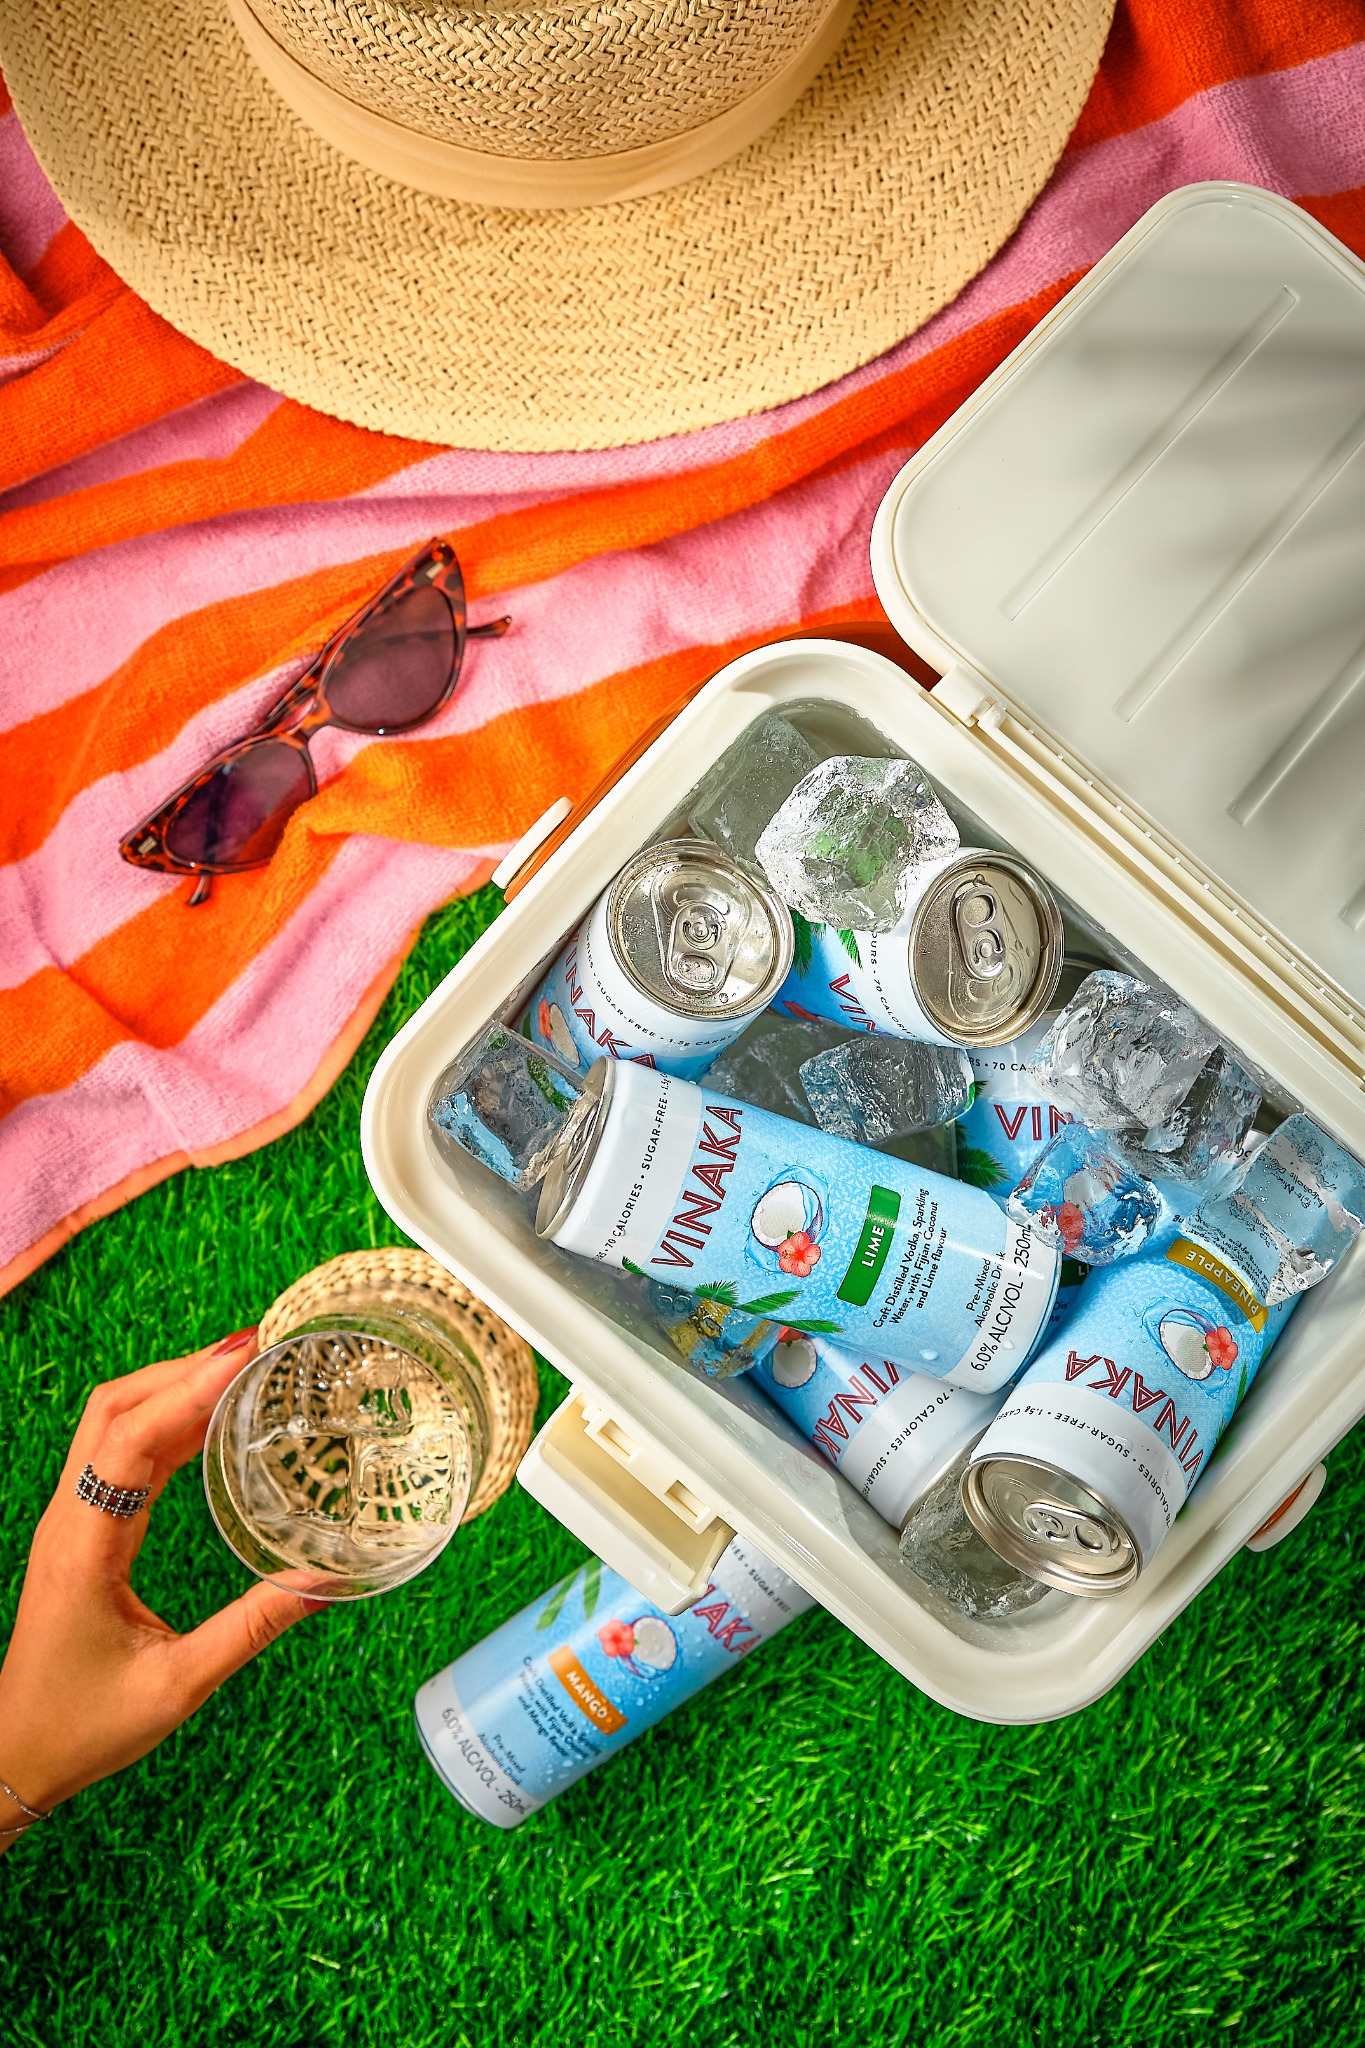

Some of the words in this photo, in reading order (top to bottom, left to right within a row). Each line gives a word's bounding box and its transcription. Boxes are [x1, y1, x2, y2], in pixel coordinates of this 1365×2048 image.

[566, 930, 656, 1070] INAKA
[874, 979, 883, 992] 70
[992, 1062, 1006, 1071] 70
[604, 1238, 617, 1248] 70
[612, 1183, 643, 1237] CALORIES
[641, 1097, 668, 1170] SUGAR-FREE
[650, 1105, 743, 1268] VINAKA
[912, 1188, 930, 1228] Sparkling
[923, 1201, 938, 1240] Coconut
[861, 1225, 885, 1268] LIME
[902, 1231, 923, 1263] Vodka,
[914, 1243, 931, 1271] Fijian
[931, 1227, 948, 1262] flavour
[885, 1265, 910, 1306] Distilled
[907, 1273, 922, 1294] with
[921, 1263, 939, 1289] Lime
[966, 1258, 991, 1311] Pre-Mixed
[1185, 1249, 1259, 1315] PINEAPPLE
[889, 1296, 914, 1324] Water,
[916, 1289, 929, 1309] and
[970, 1342, 999, 1371] 6.0%
[988, 1281, 1024, 1343] ALC/VOL
[1013, 1223, 1031, 1268] 250mL
[974, 1281, 999, 1328] Alcoholic
[872, 1306, 892, 1328] Craft
[936, 1392, 950, 1405] 70
[1024, 1405, 1043, 1416] 1.5g
[890, 1404, 935, 1451] CALORIES
[1054, 1412, 1130, 1458] SUGAR-FREE
[1065, 1350, 1204, 1490] VINAKA
[1138, 1463, 1170, 1513] CALORIES
[566, 1670, 608, 1718] MANGO
[527, 1710, 550, 1737] Mango
[442, 1708, 464, 1740] 6.0%
[457, 1739, 498, 1788] ALC/VOL
[477, 1733, 504, 1770] Alcoholic
[493, 1734, 527, 1773] Pre-Mixed
